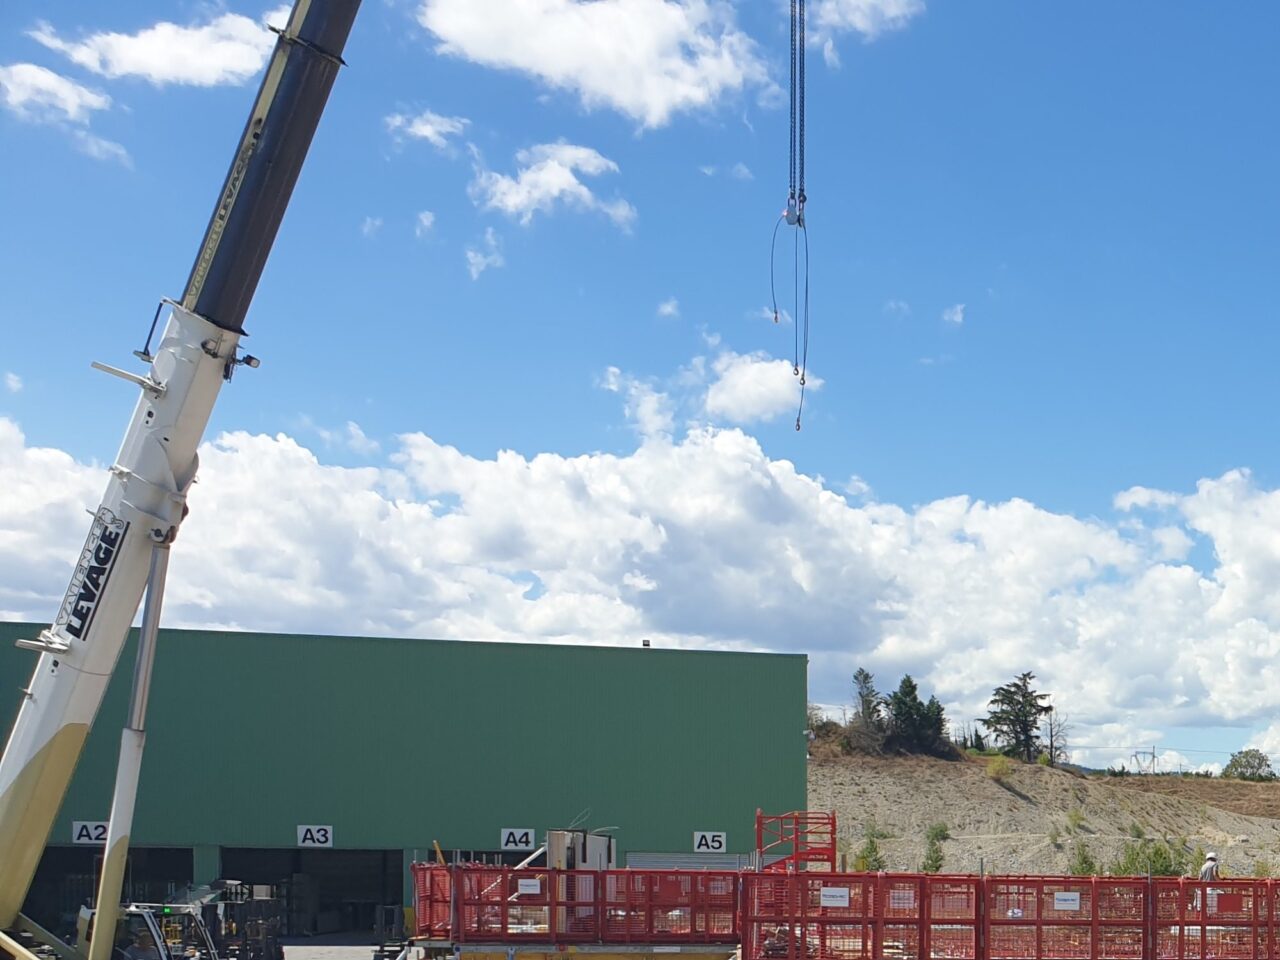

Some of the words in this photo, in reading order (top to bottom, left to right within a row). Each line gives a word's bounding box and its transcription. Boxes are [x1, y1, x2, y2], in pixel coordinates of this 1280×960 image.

[65, 525, 120, 639] LEVAGE
[76, 824, 108, 841] A2
[301, 828, 329, 844] A3
[504, 831, 531, 848] A4
[696, 834, 723, 850] A5
